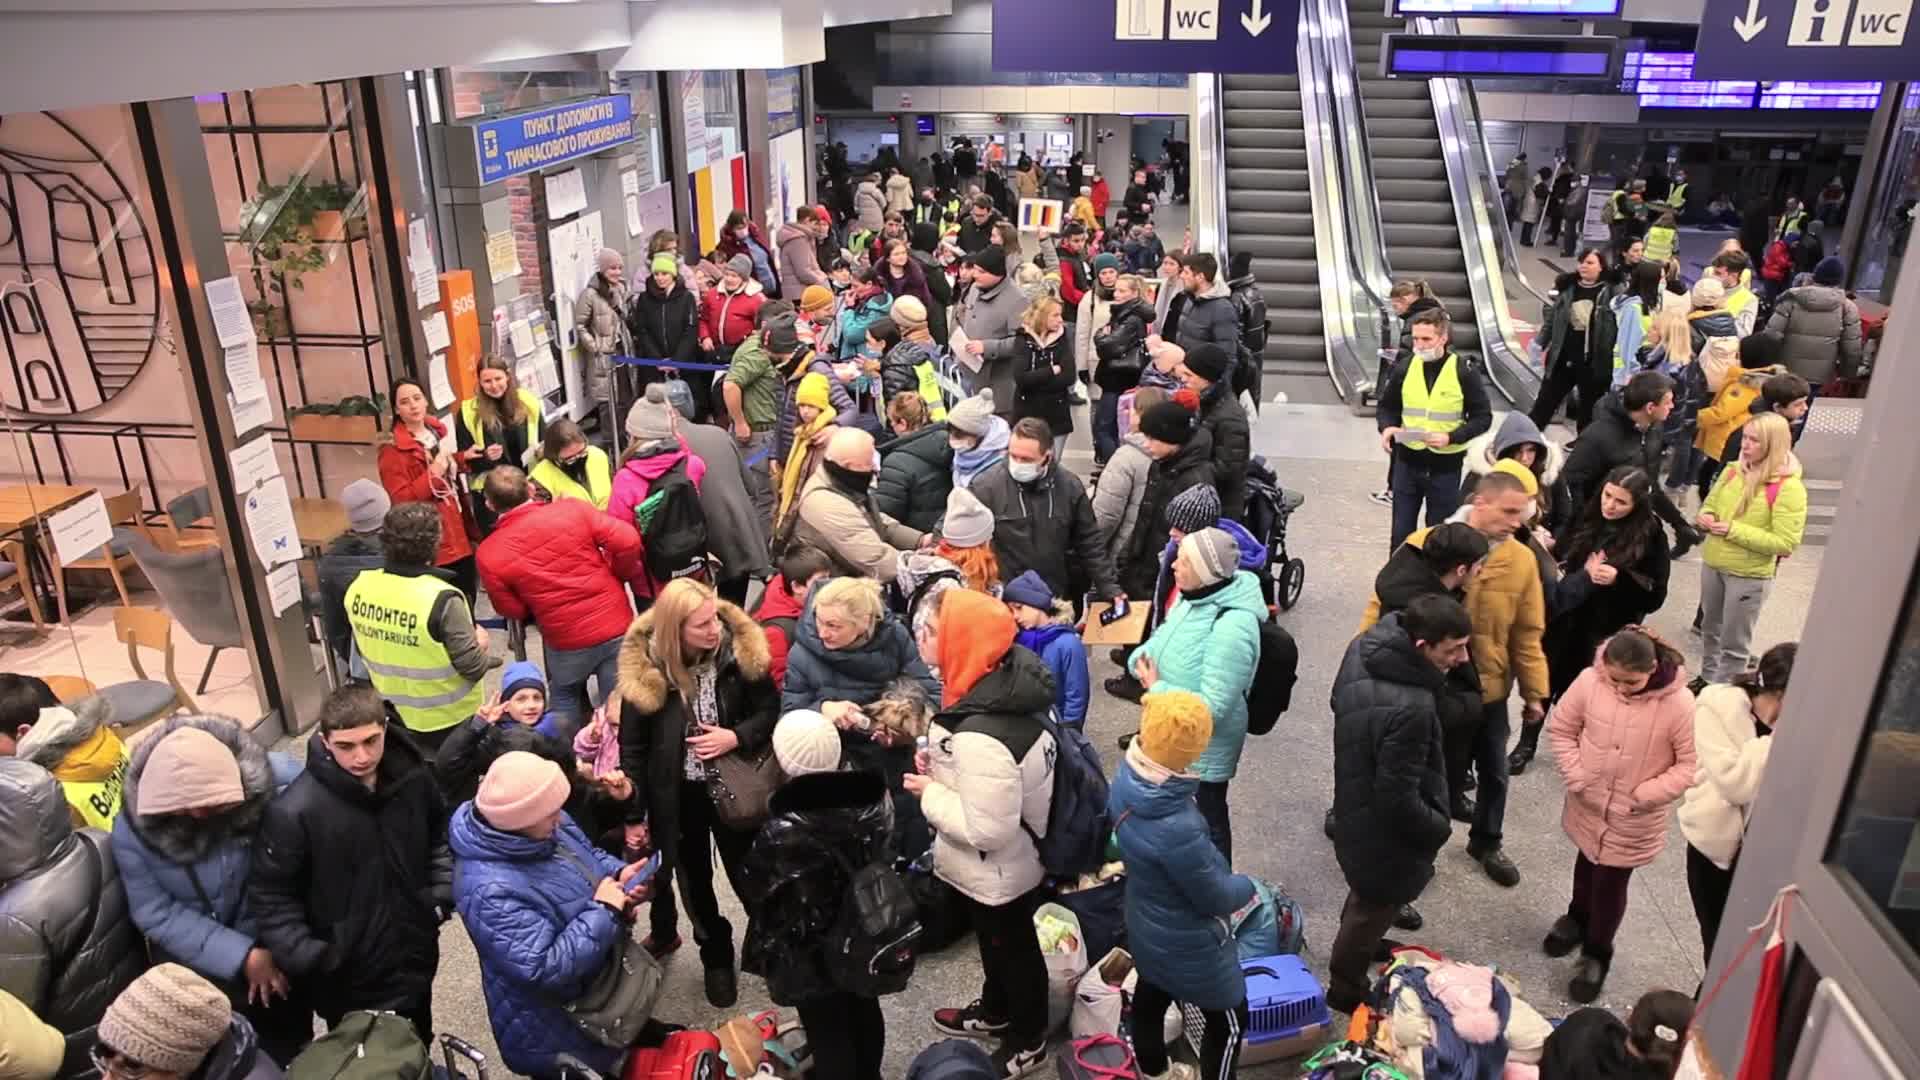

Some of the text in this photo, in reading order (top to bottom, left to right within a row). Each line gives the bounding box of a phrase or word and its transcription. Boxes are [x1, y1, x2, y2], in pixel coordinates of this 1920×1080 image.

[1176, 10, 1211, 29] WC
[1860, 13, 1902, 34] WC
[523, 114, 556, 140] ПУНКТ
[556, 103, 605, 134] ДОПОМОГИ
[504, 120, 631, 170] ТИМЧАСОВОГО ПРОЖИВАННЯ
[452, 294, 475, 316] SOS
[352, 595, 417, 632] Волонтер
